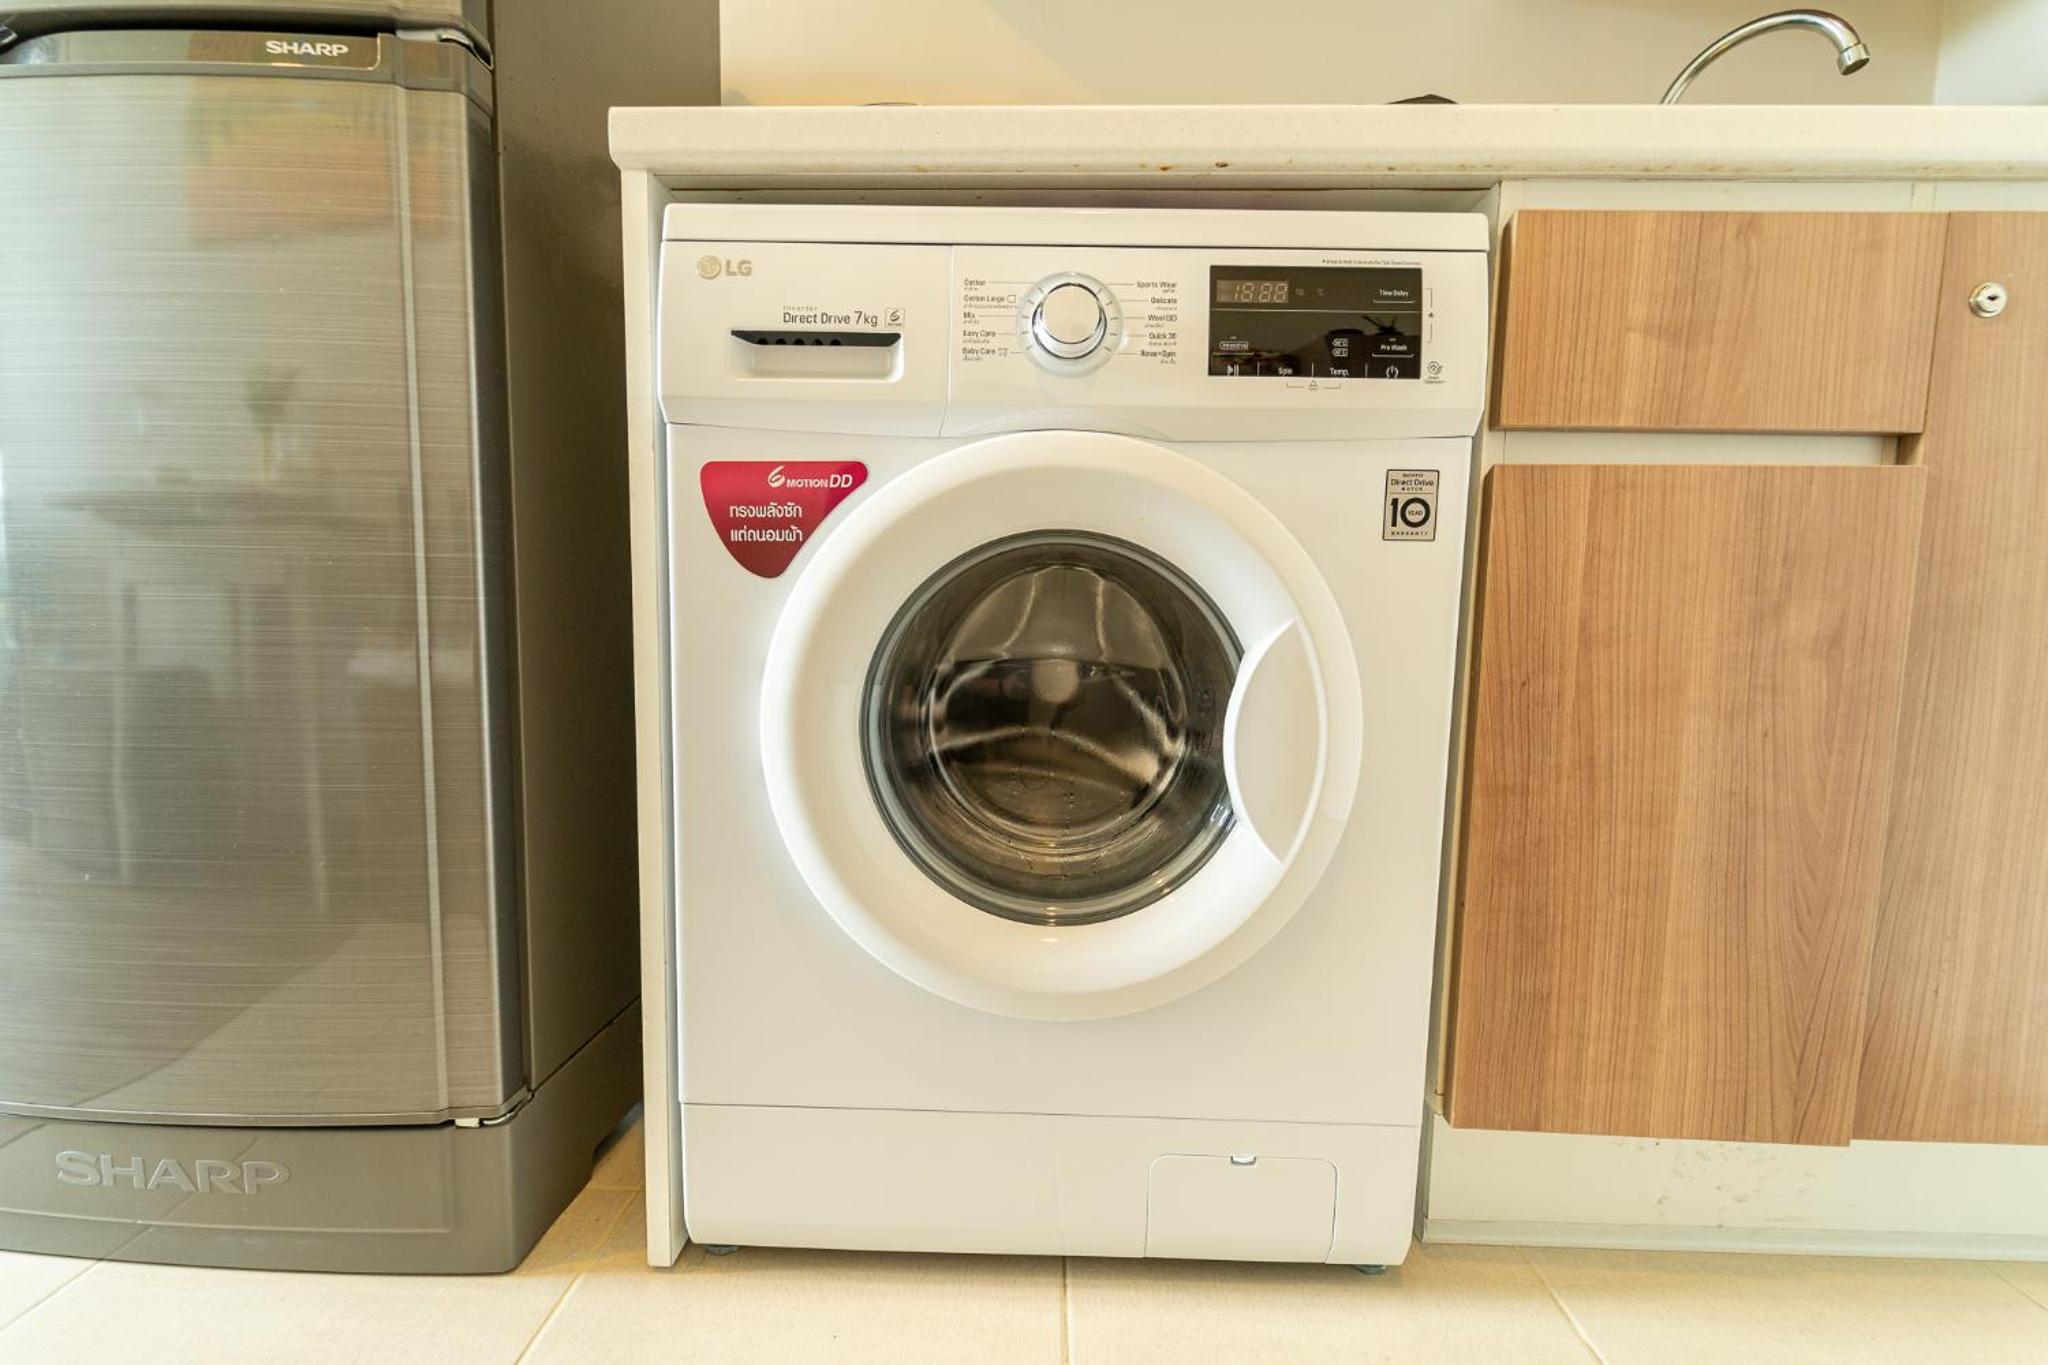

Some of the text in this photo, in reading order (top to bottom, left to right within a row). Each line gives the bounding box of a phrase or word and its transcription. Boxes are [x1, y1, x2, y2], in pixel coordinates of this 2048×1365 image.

[265, 40, 349, 57] SHARP
[725, 259, 752, 276] LG
[783, 311, 878, 327] Direct Drive 7kg
[787, 478, 829, 488] MOTION
[830, 474, 852, 488] DD
[1391, 478, 1413, 486] Direct
[1390, 497, 1430, 528] 10
[55, 1150, 290, 1195] SHARP
